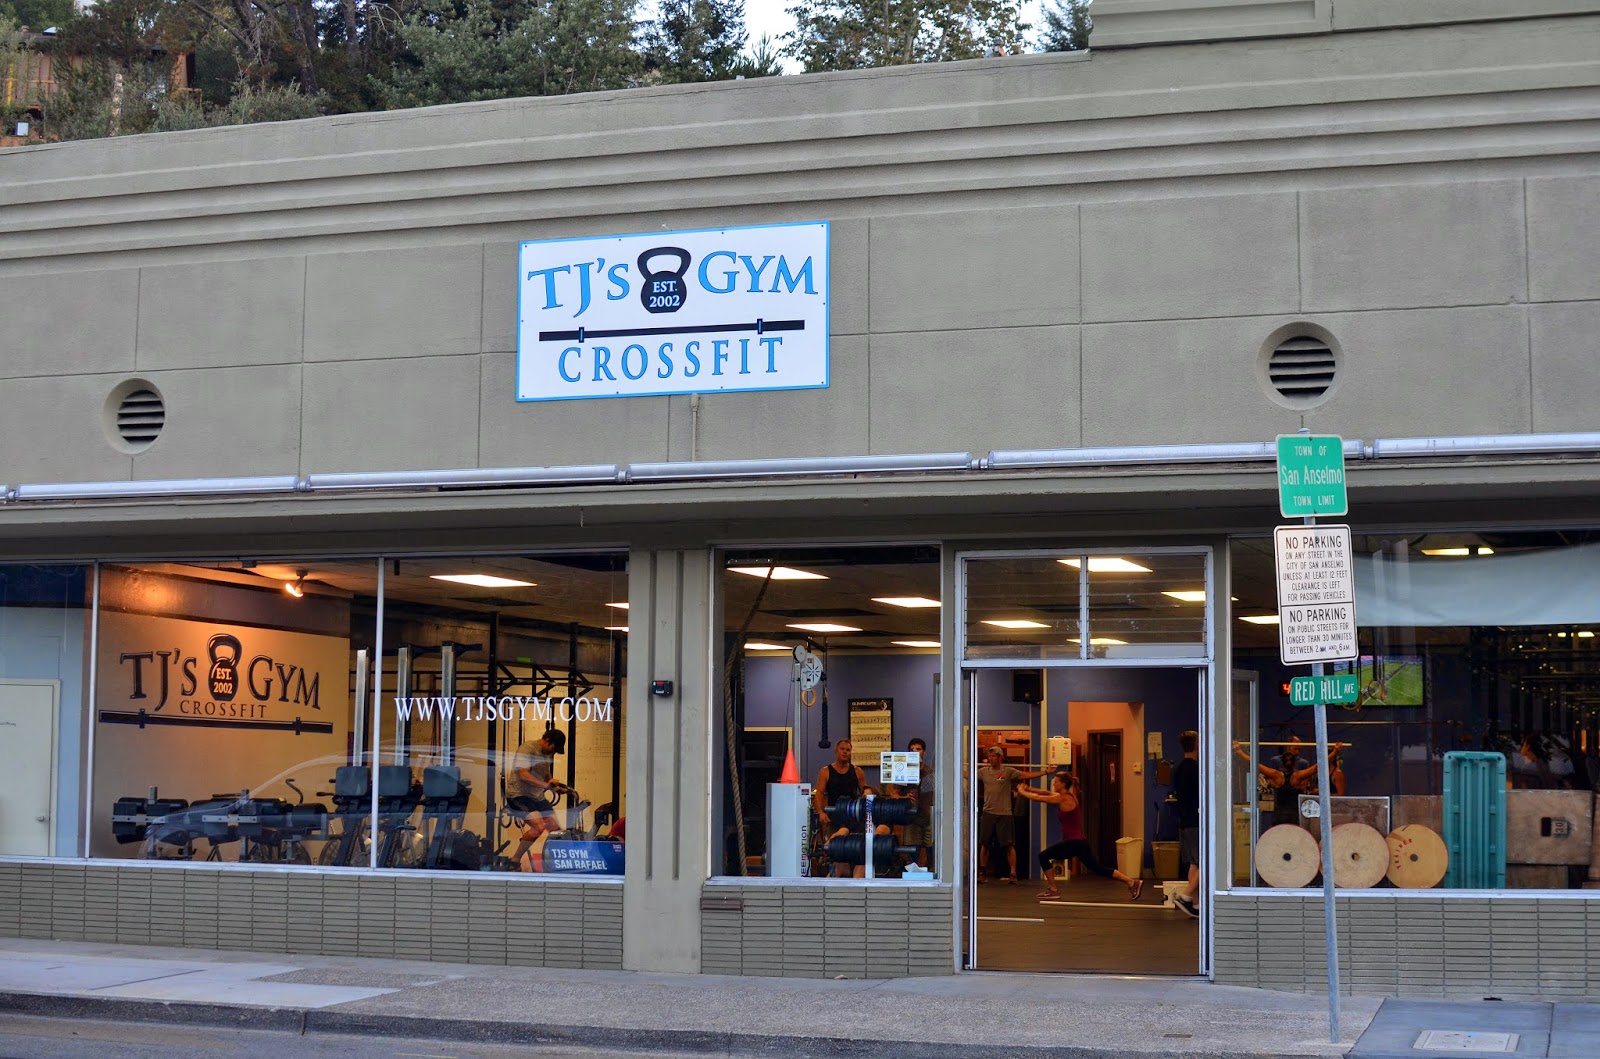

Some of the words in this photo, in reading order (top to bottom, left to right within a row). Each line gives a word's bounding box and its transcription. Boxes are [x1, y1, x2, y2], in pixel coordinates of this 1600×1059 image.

[527, 257, 630, 318] TJ'S
[698, 251, 818, 295] GYM
[652, 280, 678, 293] EST.
[649, 295, 680, 308] 2002
[558, 337, 783, 382] CROSSFIT
[1294, 446, 1312, 456] TOWN
[1318, 446, 1328, 456] OF
[1281, 465, 1300, 485] San
[1304, 465, 1342, 485] Anselmo
[1294, 496, 1312, 506] TOWN
[1318, 495, 1334, 505] LIMIT
[1286, 537, 1298, 549] NO
[1303, 536, 1342, 548] PARKING
[1321, 560, 1344, 568] ANSELMO
[1283, 572, 1302, 580] UNLESS
[1313, 571, 1328, 579] LEAST
[1336, 570, 1348, 578] FEET
[1292, 582, 1320, 591] CLEARANCE
[1329, 581, 1340, 589] LEFT
[1288, 593, 1297, 601] FOR
[1300, 592, 1320, 600] PASSING
[1323, 591, 1346, 599] VEHICLES
[1290, 610, 1303, 622] NO
[1307, 608, 1346, 622] PARKING
[1298, 625, 1315, 633] PUBLIC
[1317, 623, 1337, 632] STREETS
[1286, 636, 1305, 644] LONGER
[1308, 635, 1320, 643] THAN
[1331, 632, 1352, 641] MINUTES
[1290, 646, 1313, 654] BETWEEN
[120, 648, 197, 712] TJ'S
[248, 654, 321, 710] GYM
[216, 668, 232, 680] EST.
[214, 682, 233, 694] 2002
[1295, 681, 1315, 701] RED
[1321, 680, 1342, 700] HILL
[1344, 683, 1354, 694] AVE
[180, 700, 267, 718] CROSSFIT
[394, 696, 613, 722] WWW.TJSGYM.COM
[551, 849, 567, 858] TJS
[569, 849, 589, 859] GYM
[554, 860, 573, 869] SAN
[574, 860, 607, 870] RAFAEL
